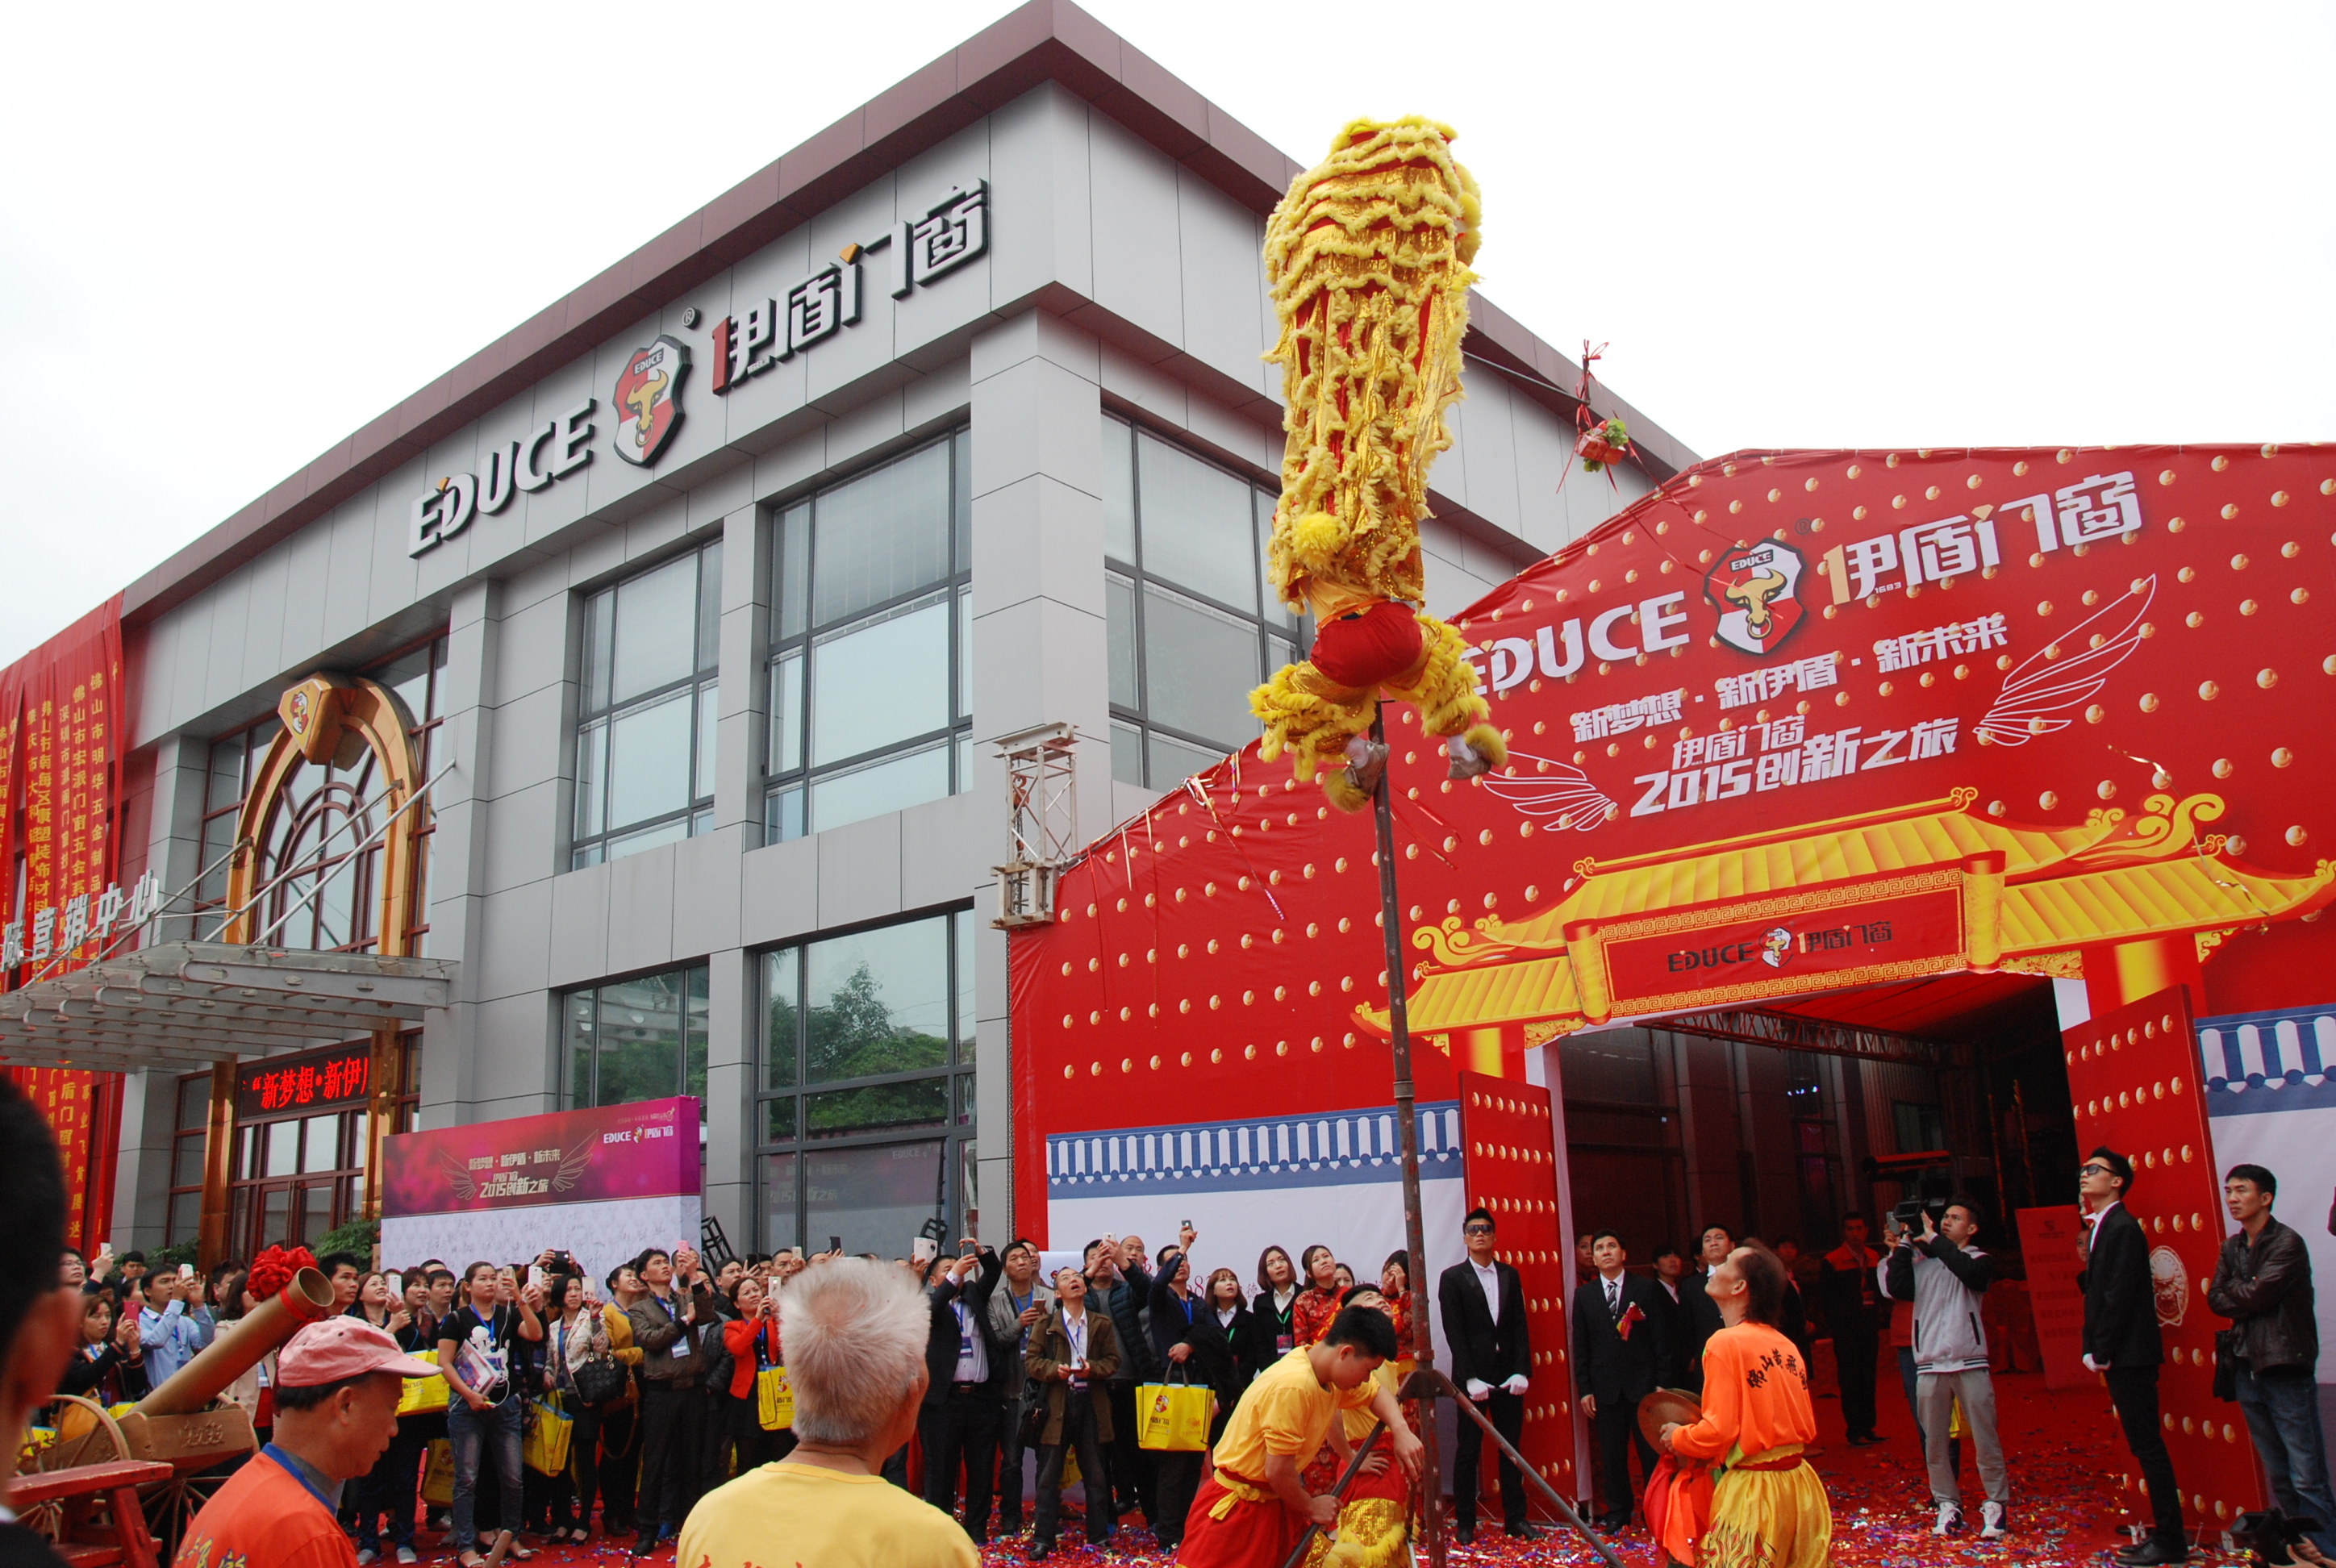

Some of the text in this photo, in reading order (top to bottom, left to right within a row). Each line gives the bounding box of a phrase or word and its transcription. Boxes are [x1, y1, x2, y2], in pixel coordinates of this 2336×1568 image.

[635, 352, 662, 375] EDUCE
[409, 398, 597, 558] EDUCE
[1731, 550, 1772, 571] EDUCE
[1875, 581, 1902, 594] 1683
[1666, 941, 1754, 973] EDUCE
[603, 1131, 632, 1145] EDUCE
